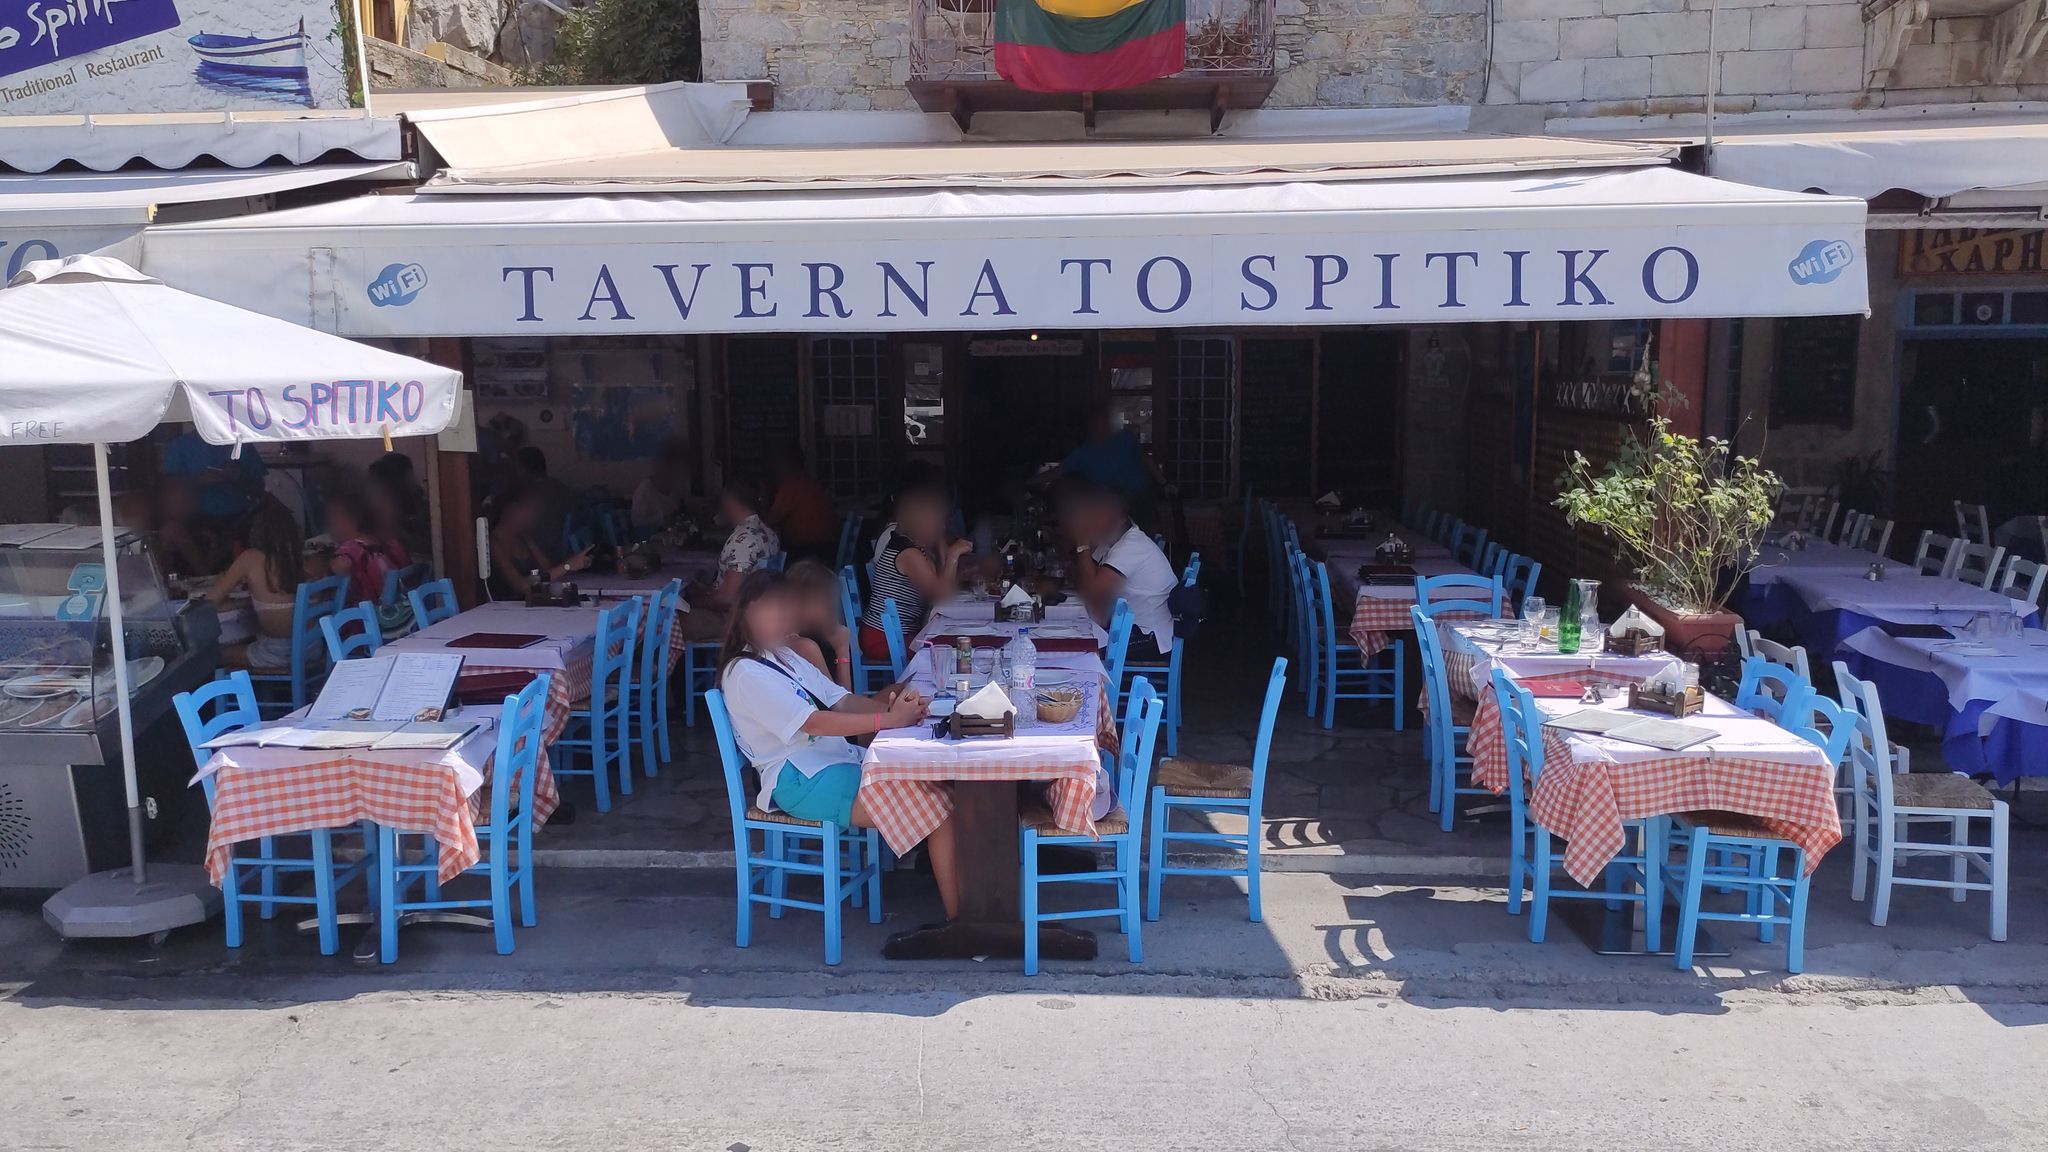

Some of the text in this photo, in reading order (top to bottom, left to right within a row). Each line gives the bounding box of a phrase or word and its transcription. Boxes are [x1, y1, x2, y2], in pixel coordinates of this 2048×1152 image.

[0, 45, 165, 104] Traditional Restaurant
[501, 245, 1701, 322] TAVERNA TO SPITIKO
[11, 420, 66, 439] FREE
[207, 379, 425, 432] TO SPITIKO
